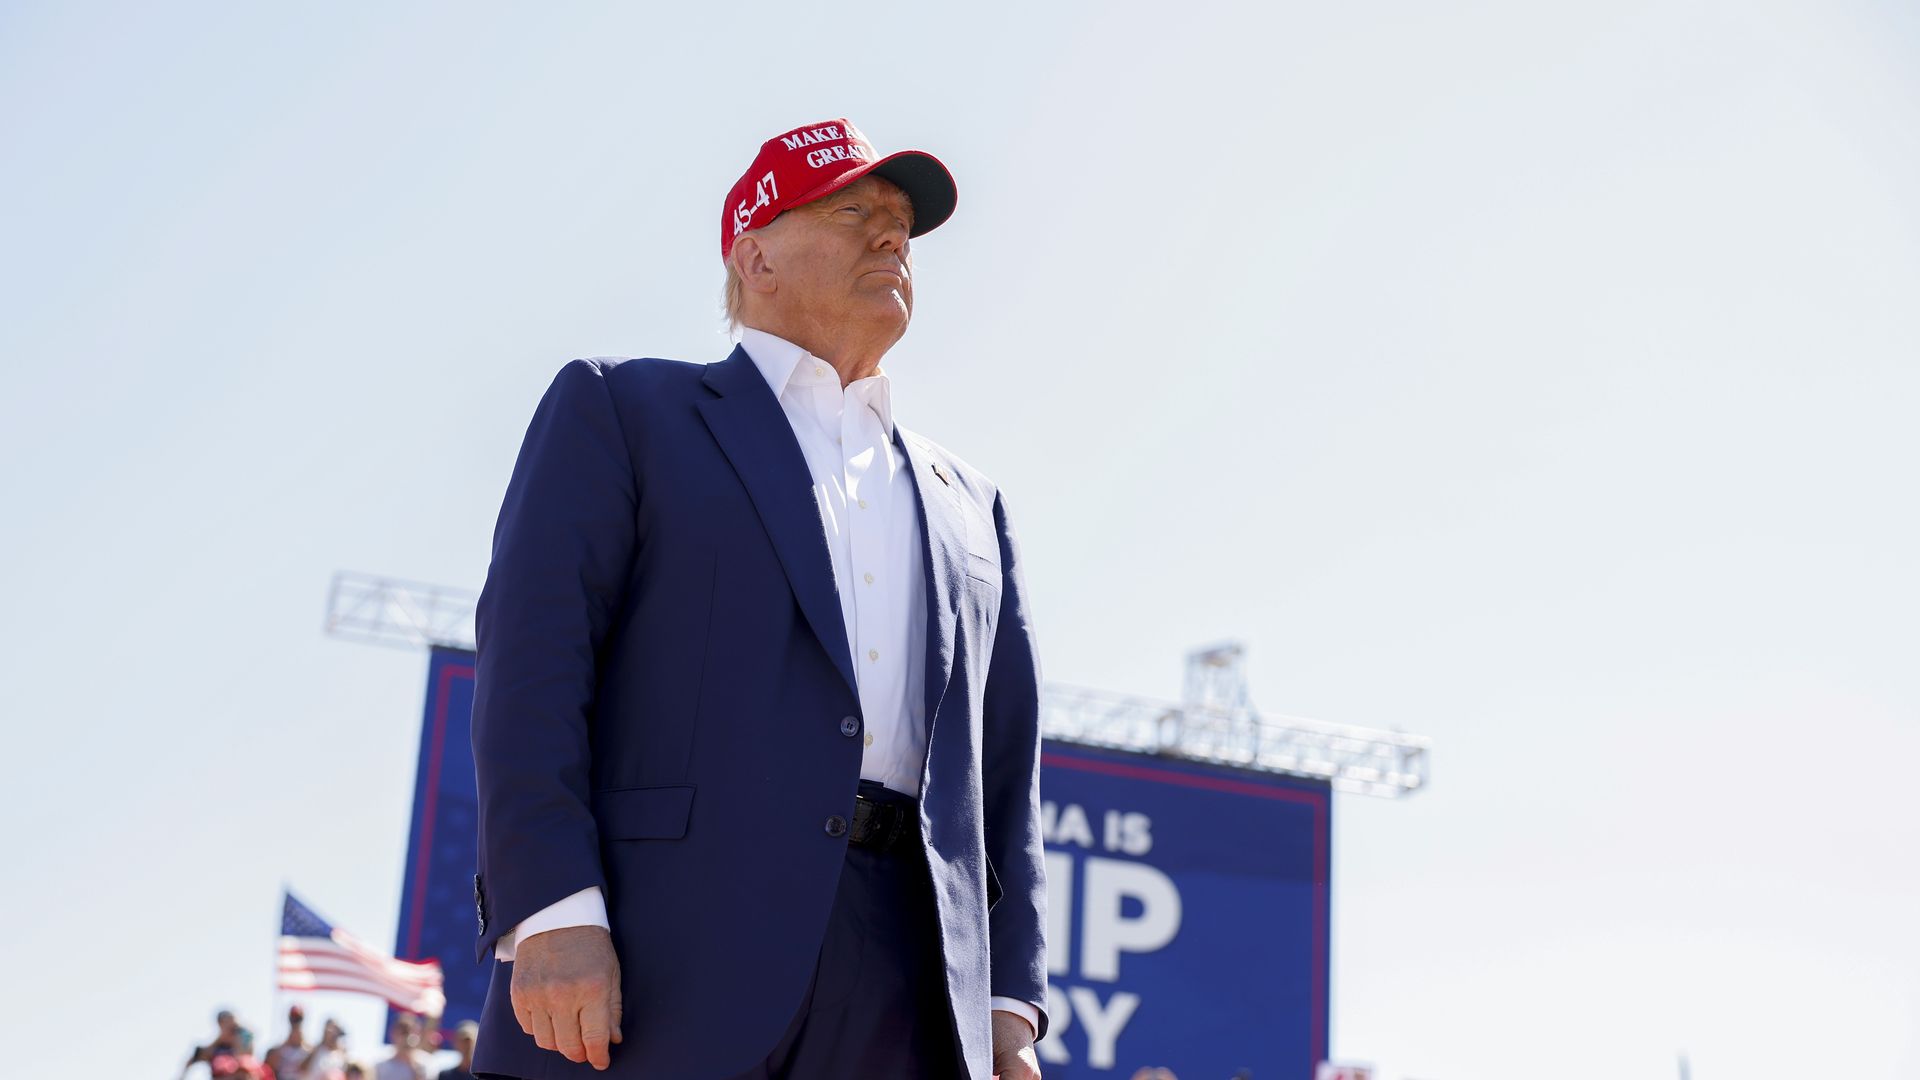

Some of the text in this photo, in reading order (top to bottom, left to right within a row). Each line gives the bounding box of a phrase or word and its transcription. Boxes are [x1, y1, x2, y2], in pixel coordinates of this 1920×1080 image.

[781, 126, 843, 151] MAKE
[806, 144, 869, 168] GREAT
[733, 170, 779, 236] 45-47
[1103, 810, 1153, 855] IS
[1045, 850, 1182, 982] P
